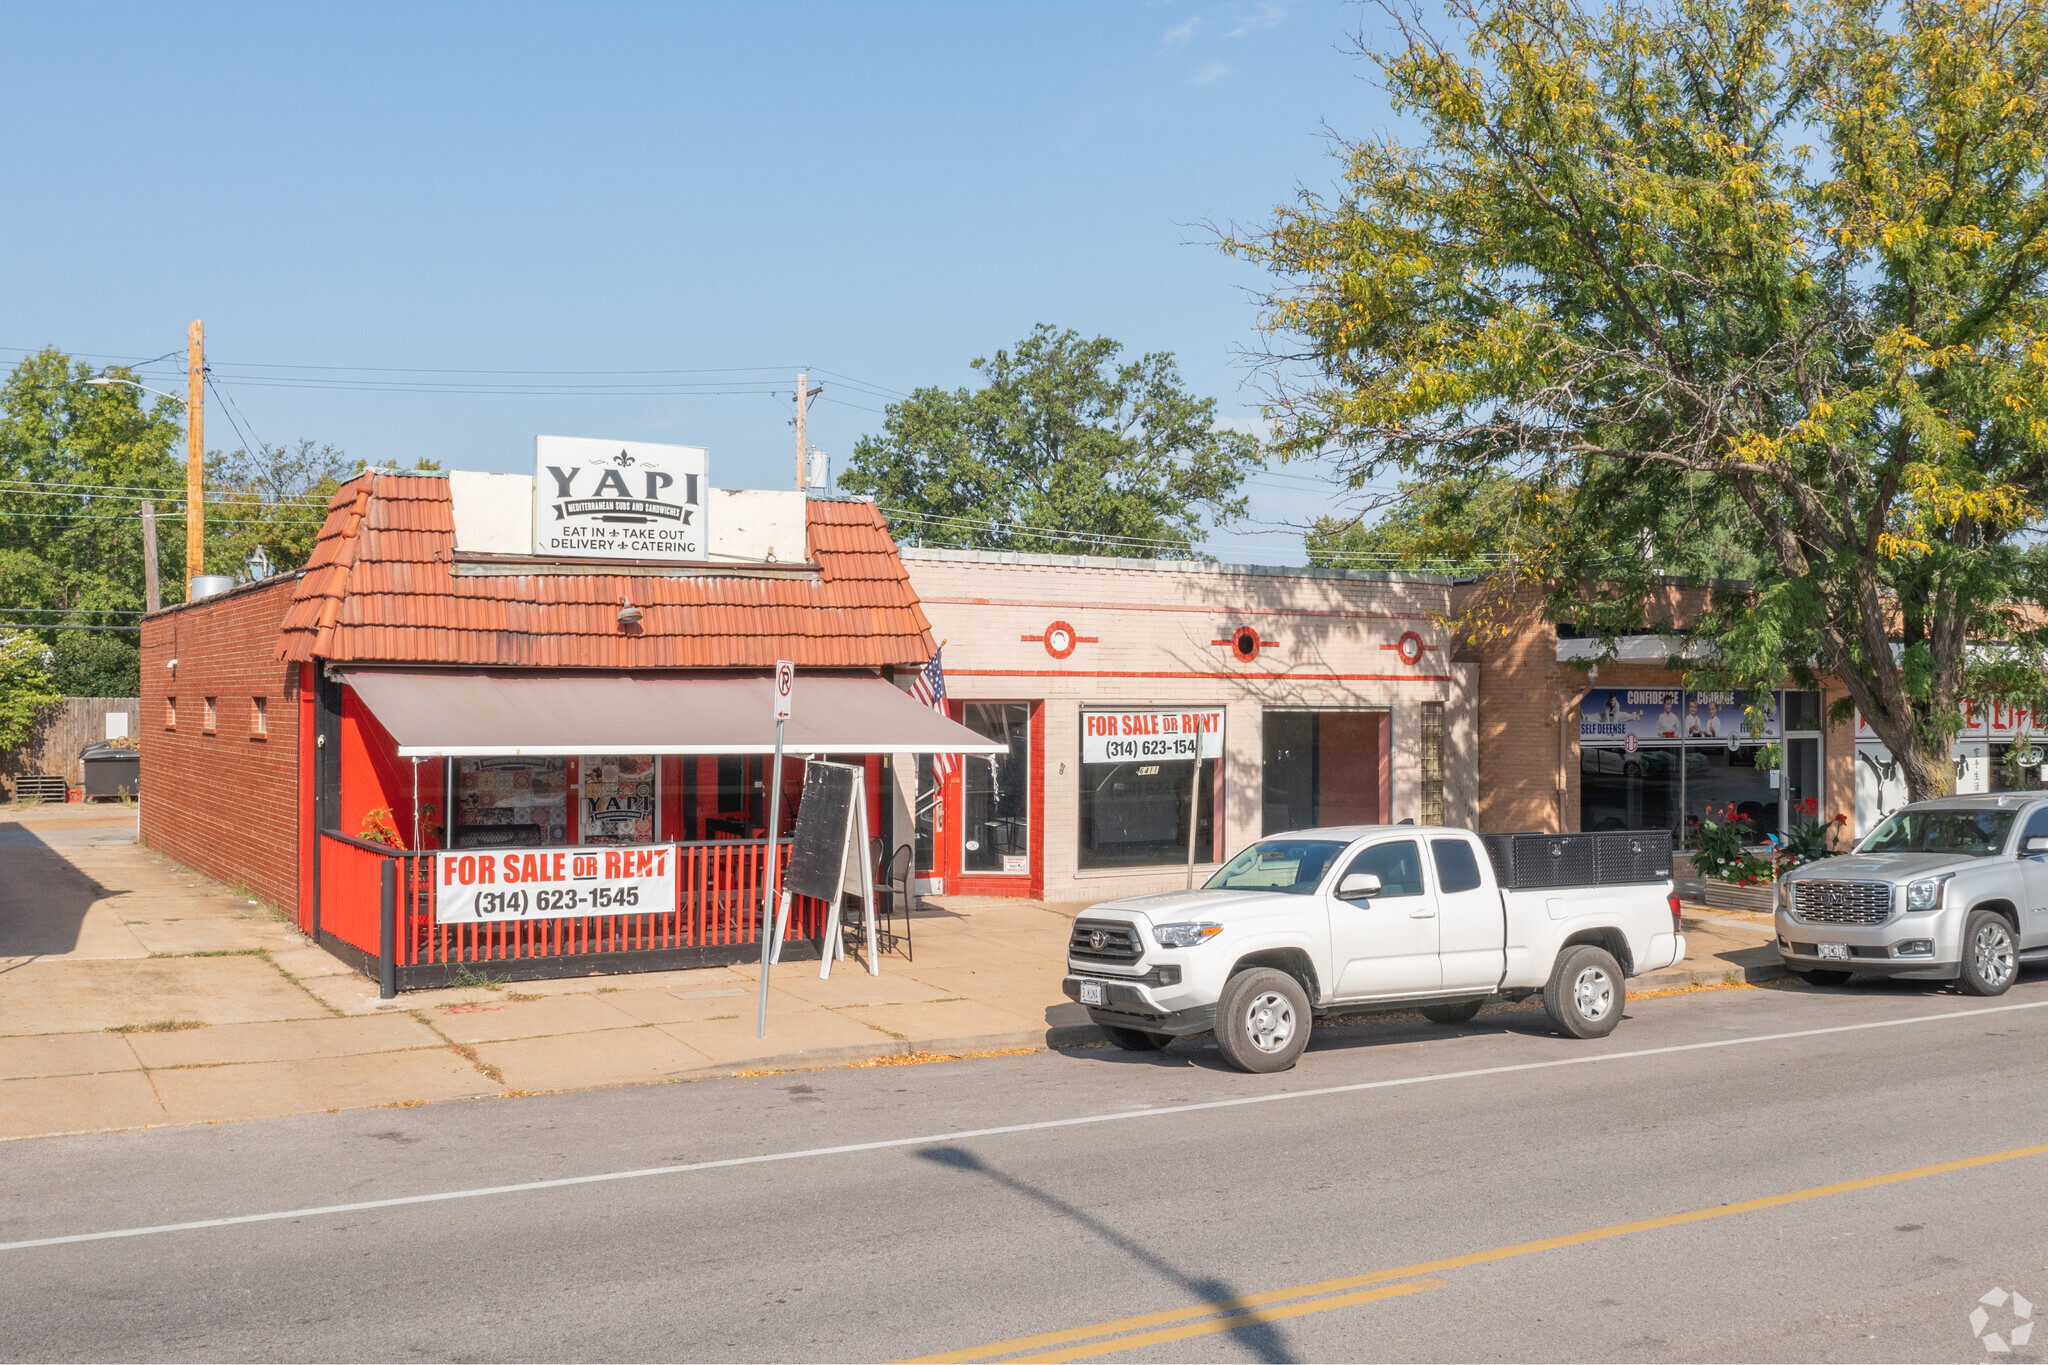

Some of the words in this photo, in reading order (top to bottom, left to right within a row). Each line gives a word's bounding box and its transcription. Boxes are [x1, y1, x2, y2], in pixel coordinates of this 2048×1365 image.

[546, 466, 699, 506] YAPI
[567, 501, 613, 512] MEDITERRANEAN
[615, 501, 630, 511] SUBS
[632, 502, 644, 512] AND
[645, 503, 680, 517] SANDWICHES
[563, 526, 587, 537] EAT
[591, 527, 605, 538] IN
[623, 528, 655, 539] TAKE
[658, 530, 685, 541] OUT
[551, 538, 615, 550] DELIVERY
[631, 541, 696, 552] CATERING
[1087, 715, 1118, 736] FOR
[1122, 715, 1159, 736] SALE
[1163, 717, 1178, 732] OR
[1581, 723, 1596, 734] SELF
[1597, 723, 1626, 734] DEFENSE
[1106, 740, 1138, 759] (314)
[588, 796, 648, 811] YAPI
[444, 855, 496, 886] FOR
[503, 853, 566, 883] SALE
[572, 856, 598, 877] OR
[604, 849, 670, 879] RENT
[474, 890, 529, 917] (314)
[536, 886, 640, 911] 623-1545
